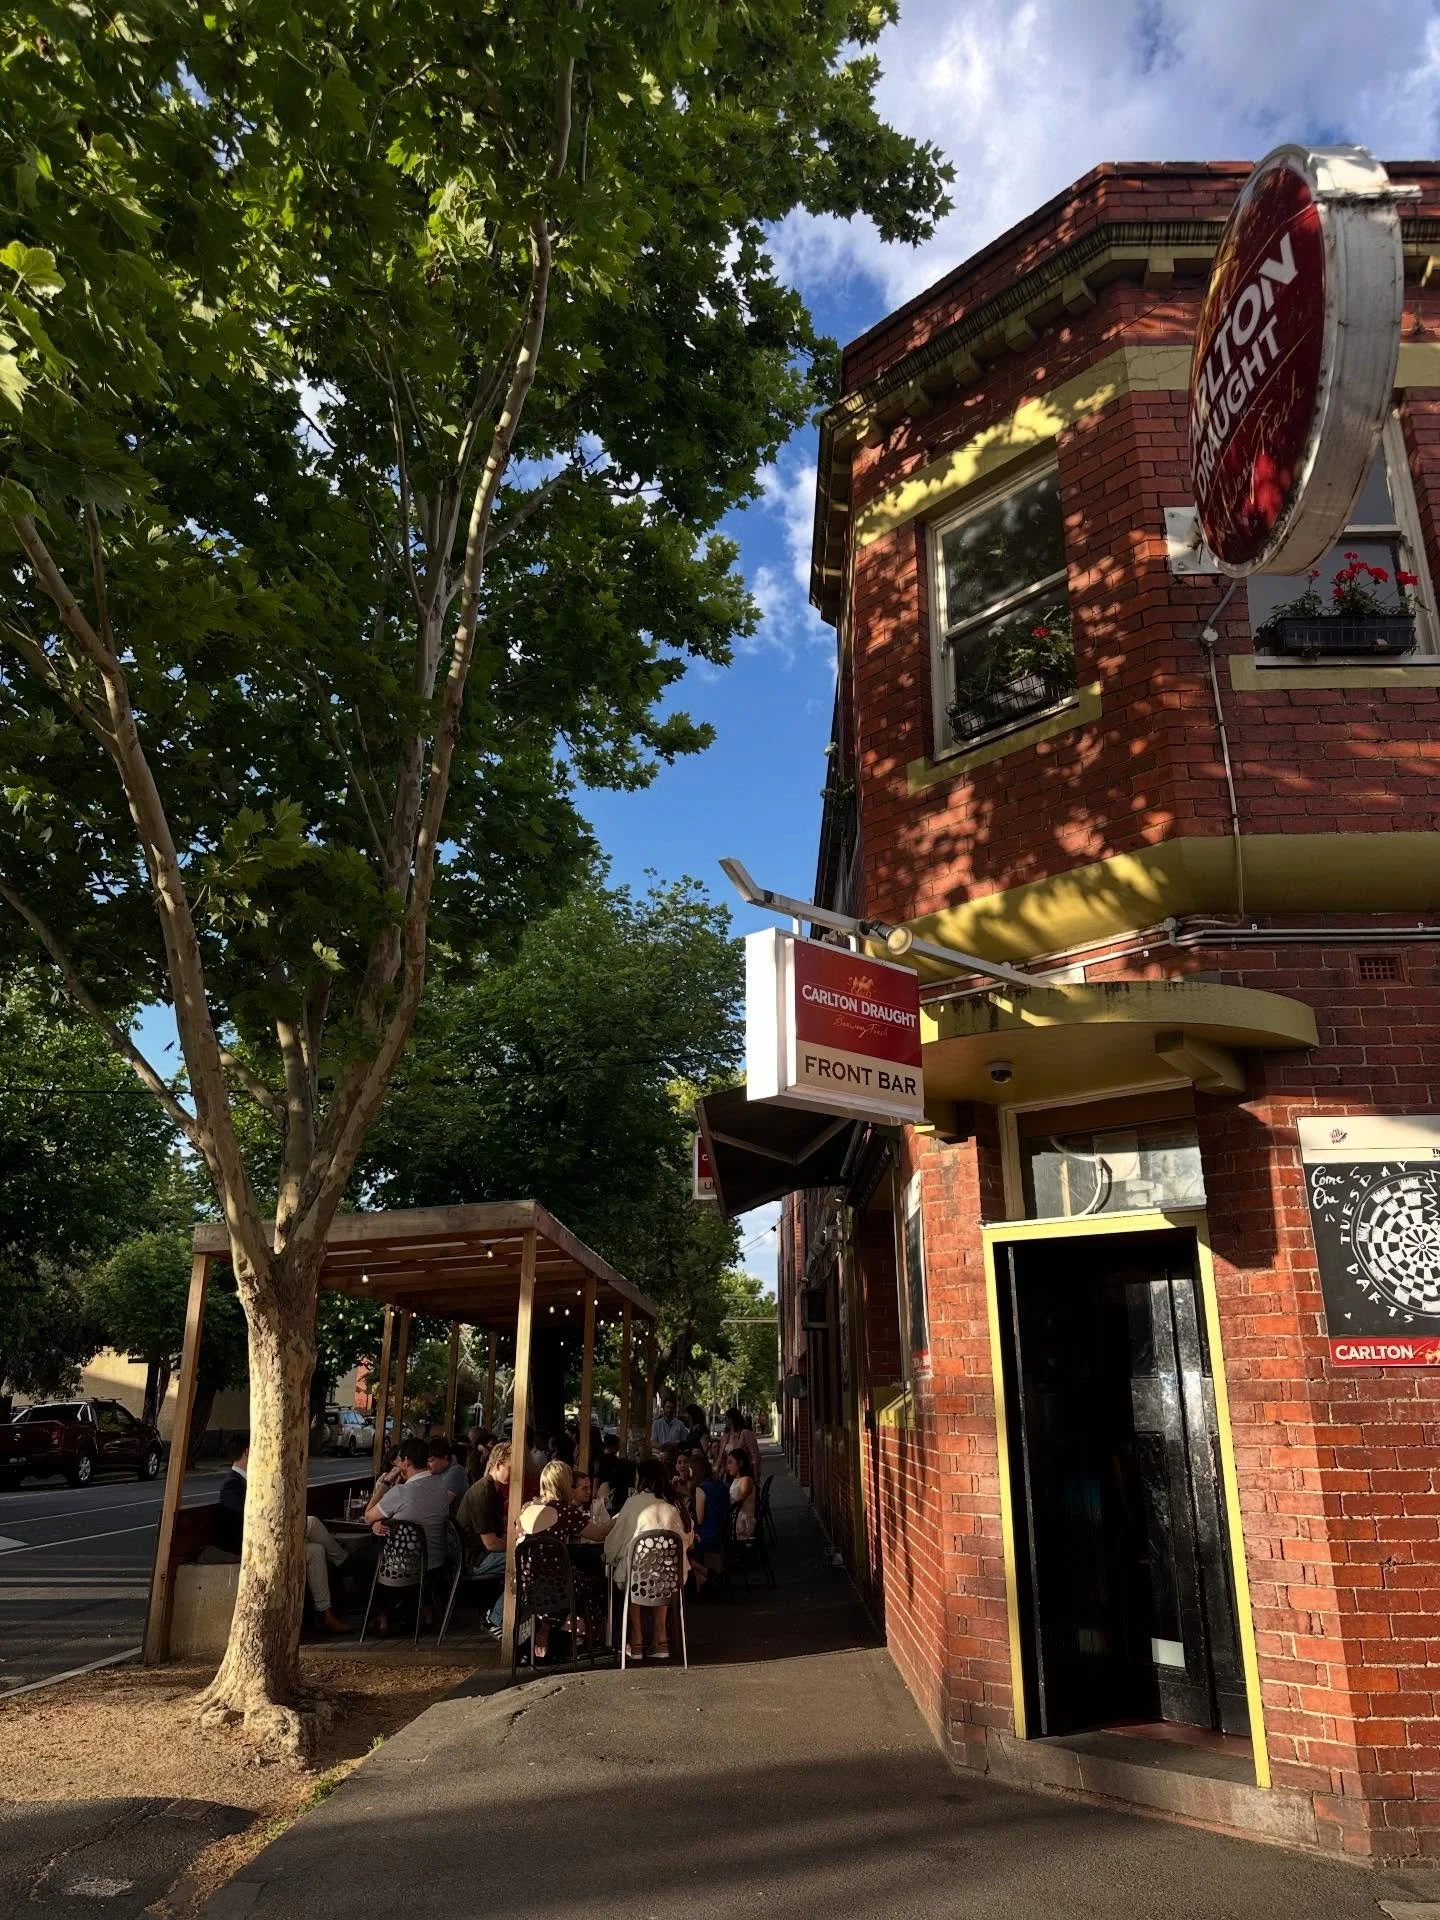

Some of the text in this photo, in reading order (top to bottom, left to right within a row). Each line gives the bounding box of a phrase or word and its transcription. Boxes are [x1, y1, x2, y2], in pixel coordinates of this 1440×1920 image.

[1196, 314, 1284, 504] DRAUGHT
[801, 984, 917, 1028] CARLTON DRAUGHT
[804, 1055, 917, 1096] FRONT BAR
[1311, 1166, 1345, 1188] Come
[1313, 1187, 1340, 1210] One
[1340, 1161, 1408, 1245] TUESDAY
[1346, 1263, 1415, 1324] DARTS
[1335, 1344, 1414, 1361] CARLTON
